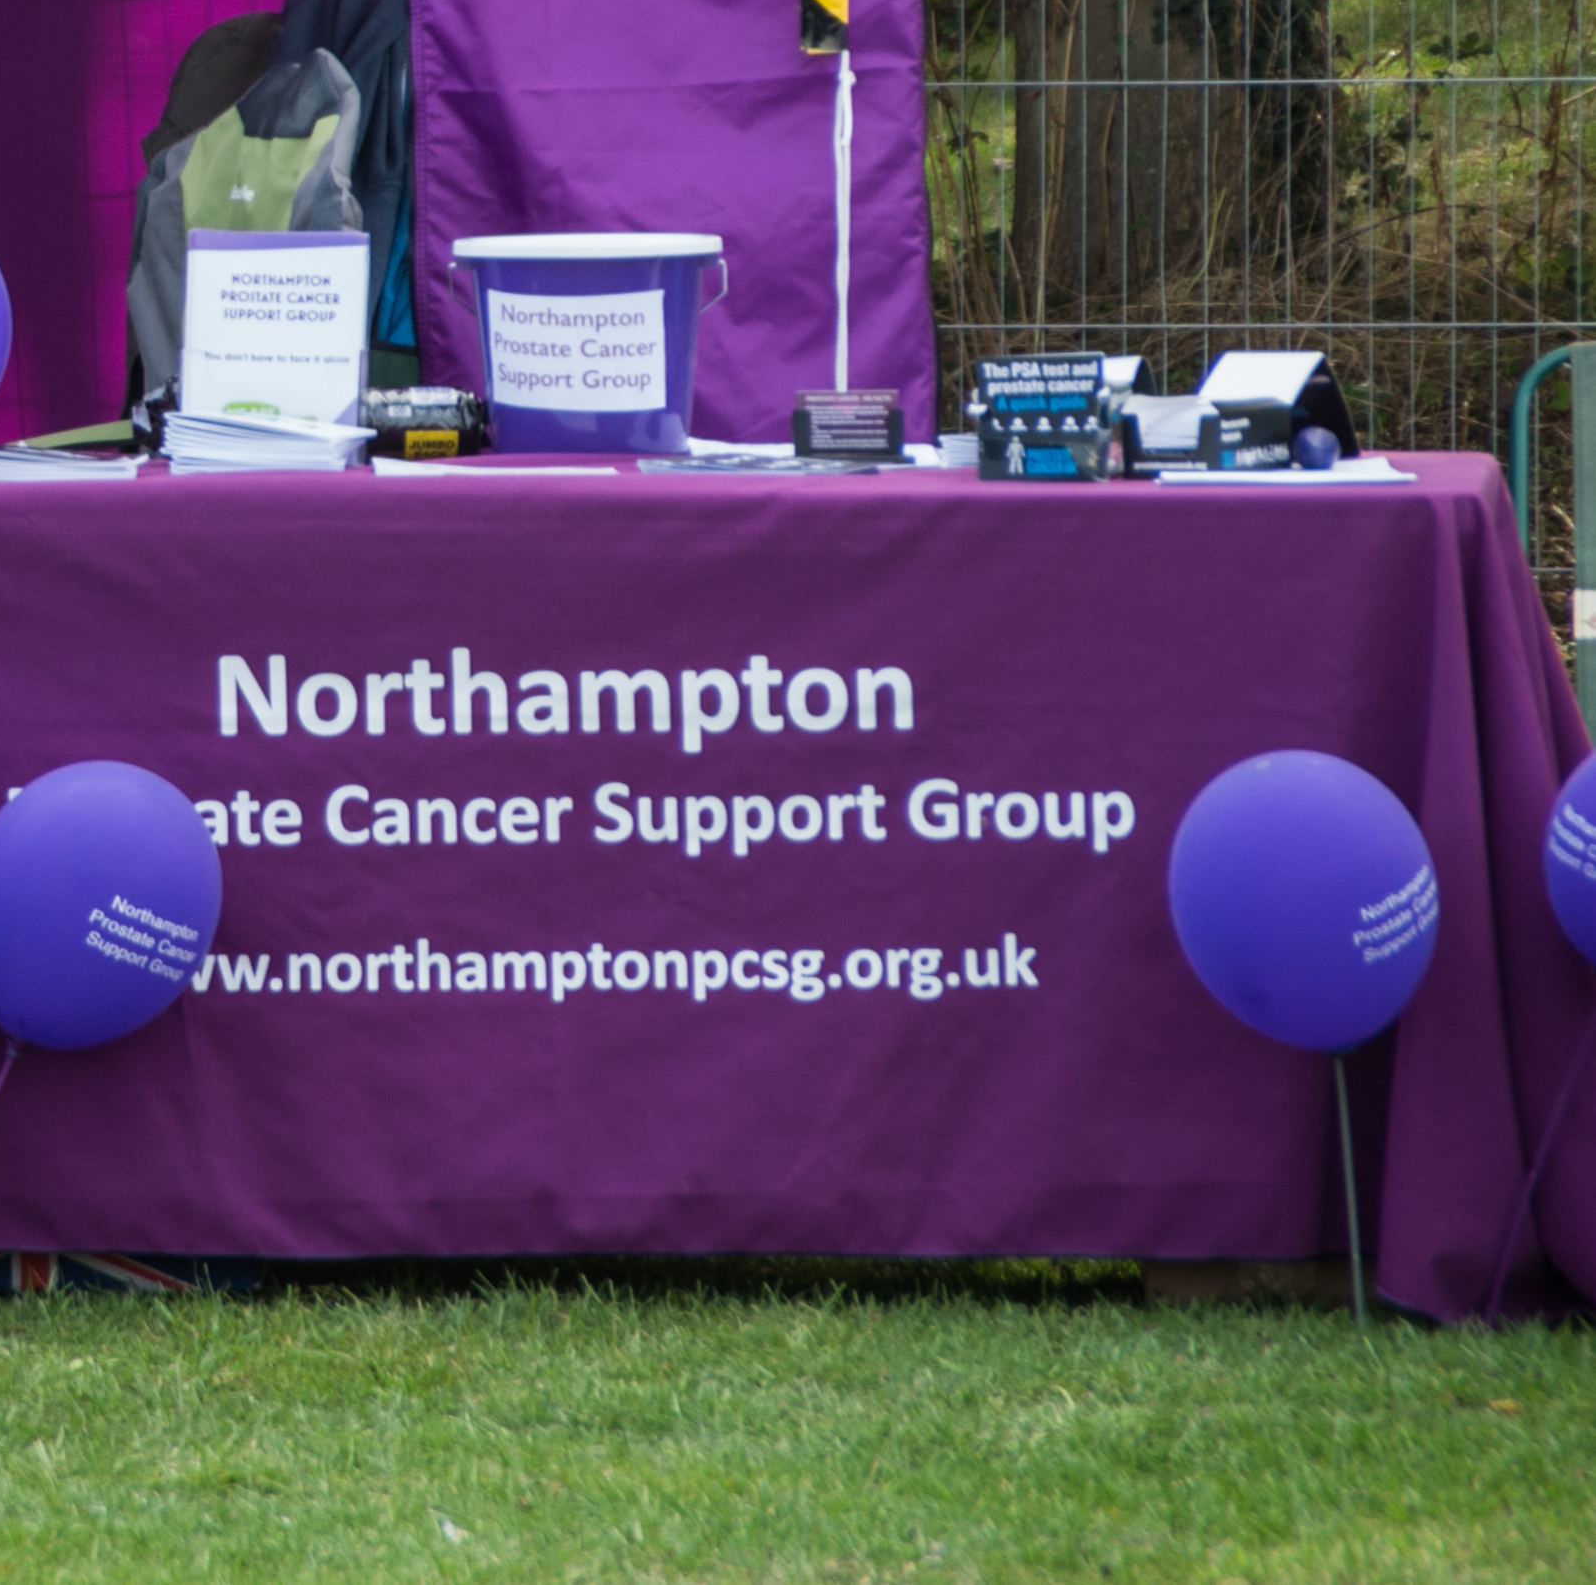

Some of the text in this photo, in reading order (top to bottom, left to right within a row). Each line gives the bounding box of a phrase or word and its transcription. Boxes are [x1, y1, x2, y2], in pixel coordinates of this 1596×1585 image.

[232, 273, 330, 286] NORTHAMPTON
[221, 290, 340, 304] PROSTATE CANCER
[223, 308, 336, 321] SUPPORT GROUP
[501, 303, 645, 332] Northampton
[494, 331, 657, 358] Prostate Cancer
[499, 363, 651, 392] Support Group
[982, 360, 1098, 378] The PSA test and
[987, 379, 1095, 397] prostate cancer
[410, 440, 455, 450] JUMBO
[217, 647, 914, 753] Northampton
[324, 783, 573, 846] Cancer
[592, 780, 886, 857] Support
[907, 778, 1136, 853] Group
[88, 908, 156, 949] Prostate
[111, 894, 199, 942] Northampton
[86, 931, 148, 968] Support
